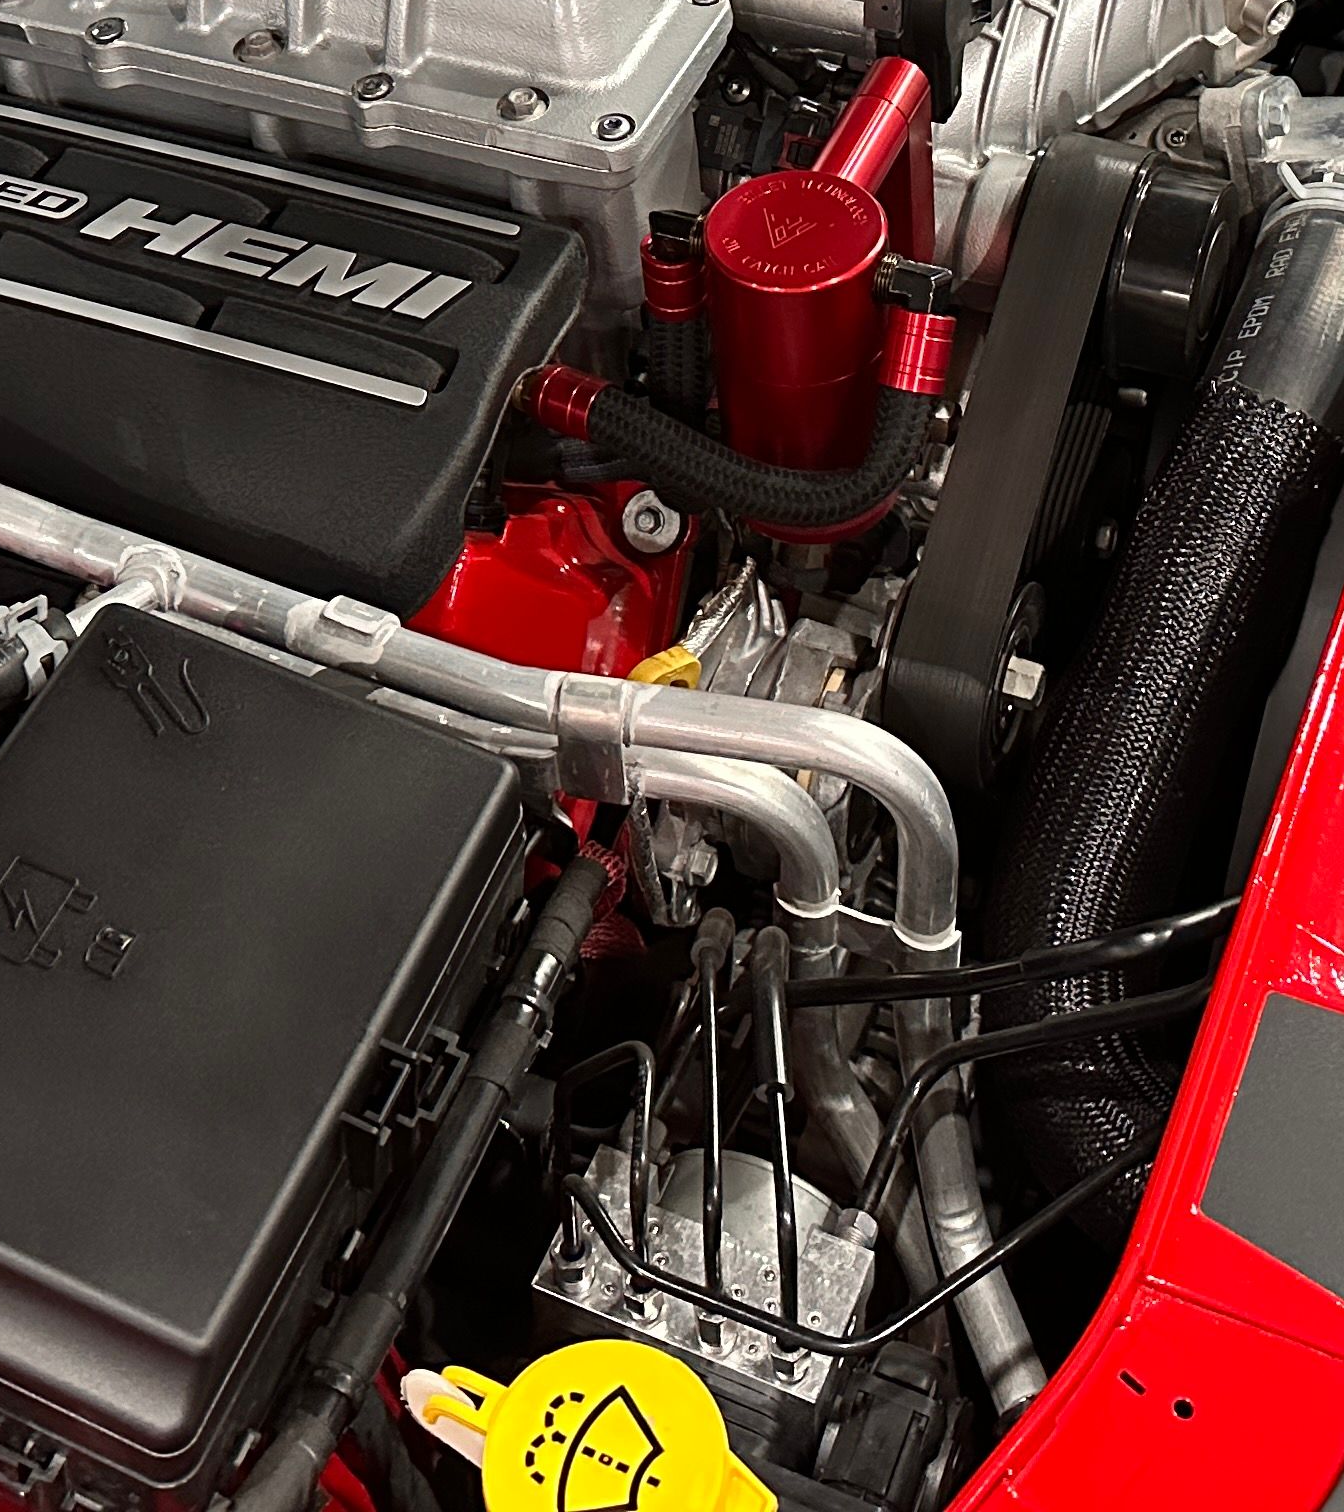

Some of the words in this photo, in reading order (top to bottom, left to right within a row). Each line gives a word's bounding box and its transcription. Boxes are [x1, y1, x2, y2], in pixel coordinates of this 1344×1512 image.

[79, 196, 473, 320] HEMI
[1237, 293, 1276, 341] EPDM
[1265, 247, 1294, 282] RAD
